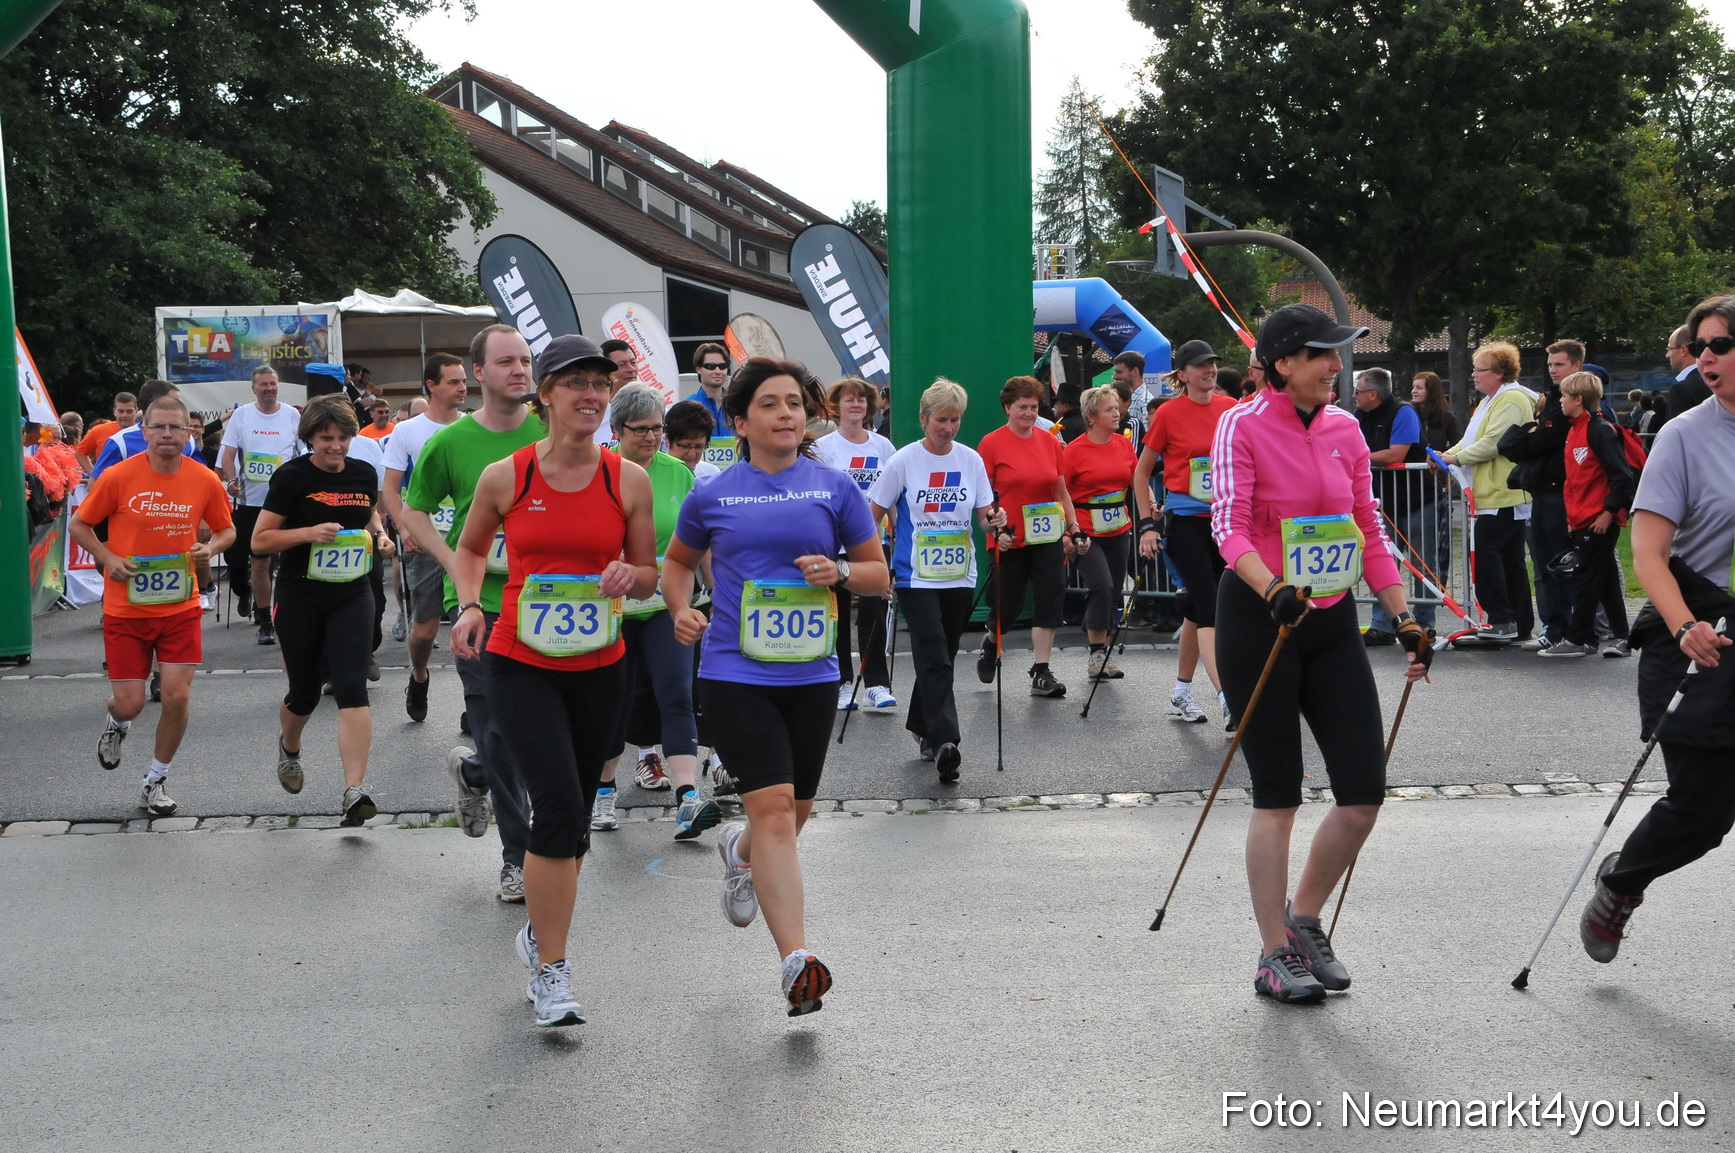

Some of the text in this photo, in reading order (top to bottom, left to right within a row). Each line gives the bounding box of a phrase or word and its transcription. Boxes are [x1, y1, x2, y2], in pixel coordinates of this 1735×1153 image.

[171, 333, 231, 354] TLA
[240, 341, 312, 363] Logistics
[703, 448, 734, 462] 1329
[248, 462, 273, 476] 503
[334, 492, 354, 500] BORN
[718, 490, 832, 508] TEPPICHLÄUFER
[916, 487, 967, 504] PERRAS
[140, 501, 192, 512] Fischer
[1102, 506, 1121, 523] 64
[1032, 516, 1051, 534] 53
[314, 548, 365, 568] 1217
[920, 547, 966, 566] 1258
[1289, 542, 1357, 576] 1327
[134, 570, 180, 593] 982
[1309, 577, 1327, 585] Jutta
[532, 590, 566, 598] firmenlauf
[529, 602, 599, 636] 733
[747, 608, 825, 640] 1305
[546, 636, 568, 644] Jutta
[765, 641, 792, 649] Karola
